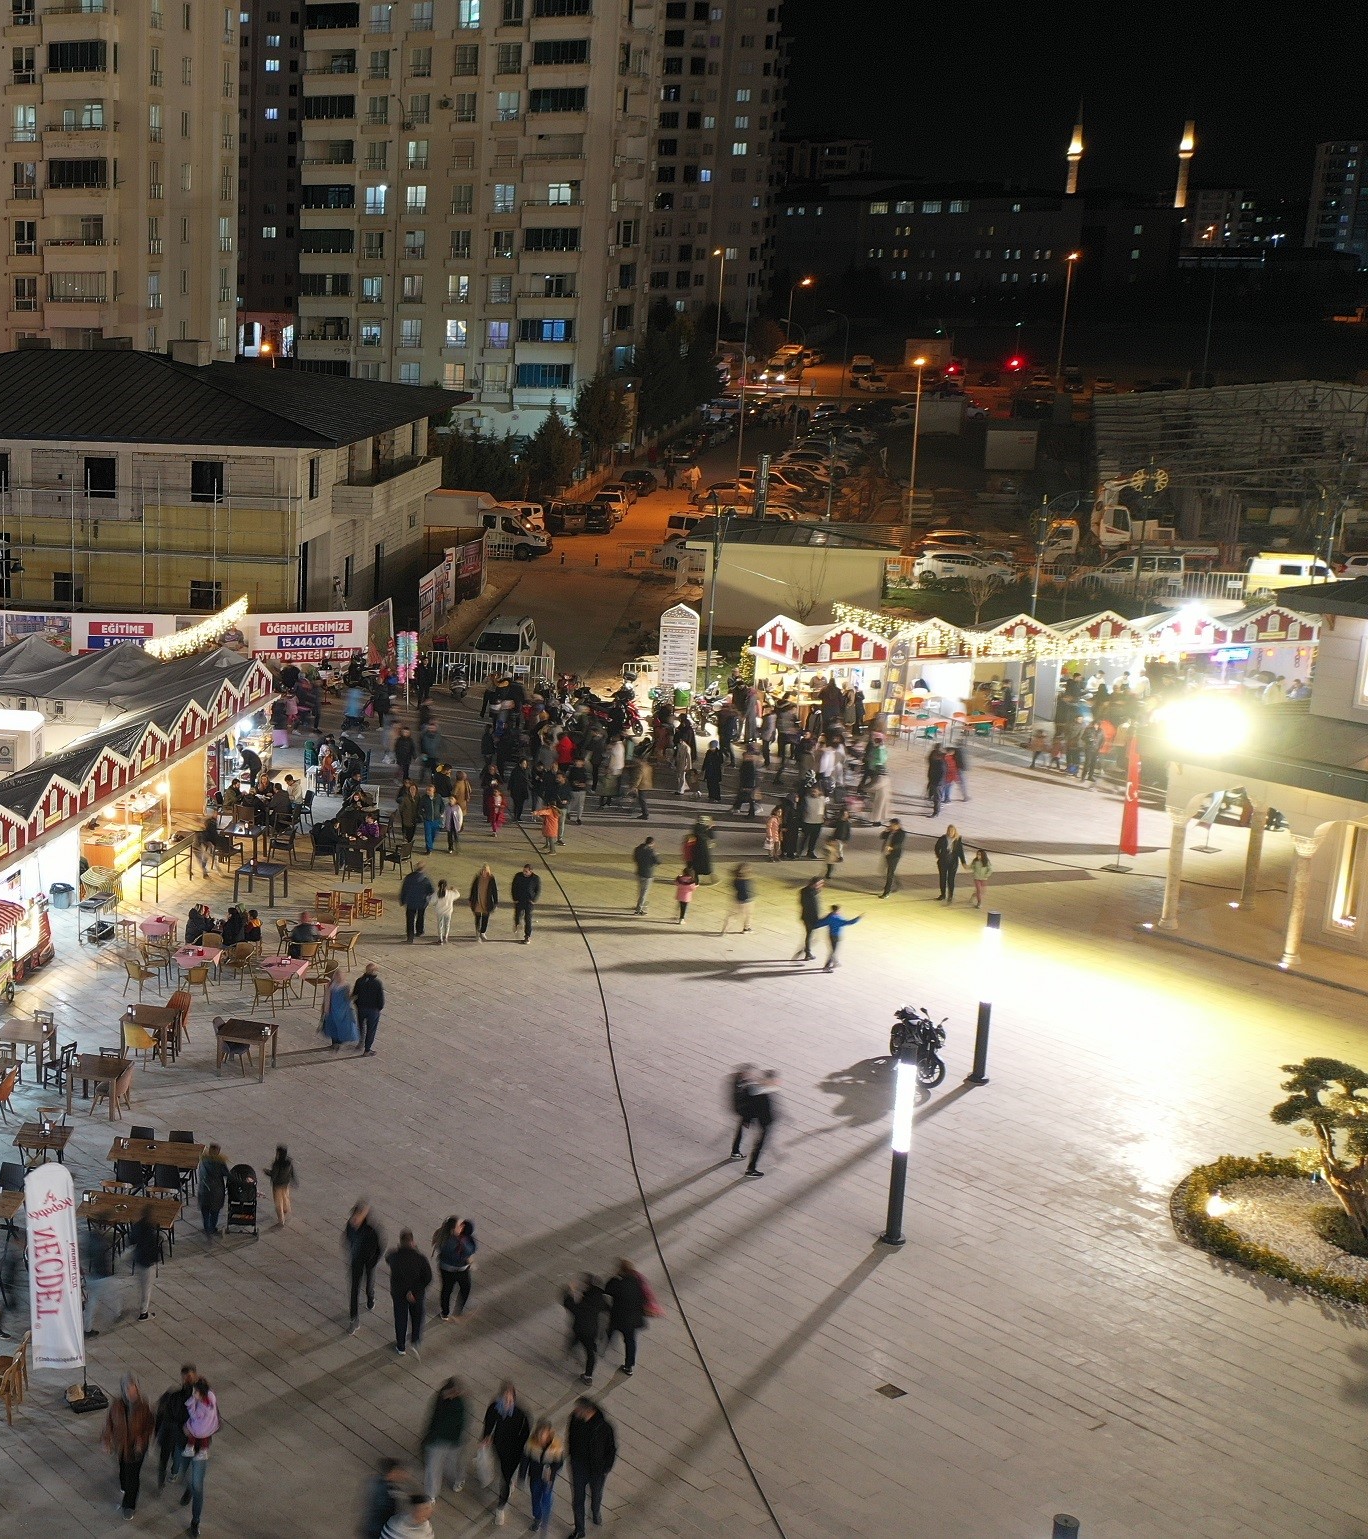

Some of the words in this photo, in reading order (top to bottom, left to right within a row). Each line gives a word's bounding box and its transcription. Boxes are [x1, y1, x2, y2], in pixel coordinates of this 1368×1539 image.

[101, 623, 145, 634] EĞİTİME
[266, 621, 350, 634] ÖĞRENCİLERİMİZE
[103, 638, 111, 647] 5
[281, 636, 334, 647] 15.444.086
[284, 648, 323, 660] DESTEĞİ
